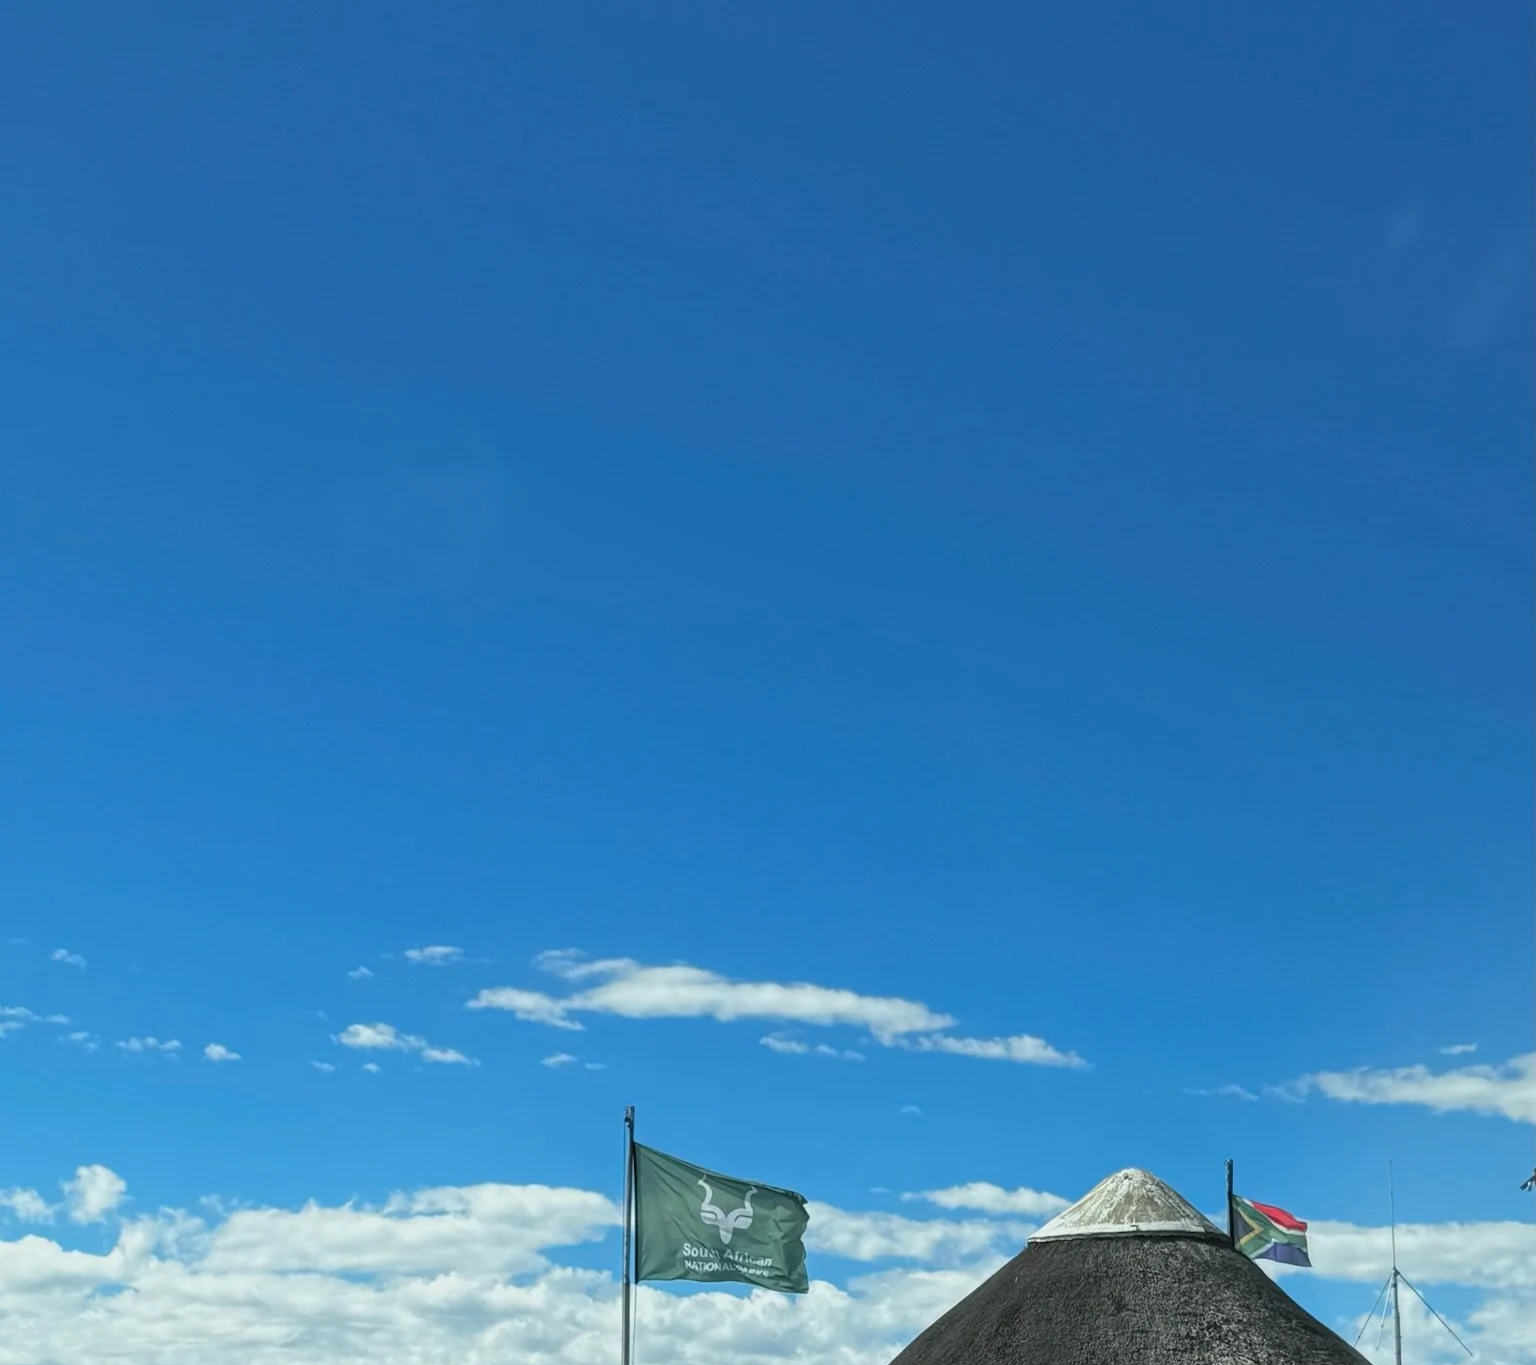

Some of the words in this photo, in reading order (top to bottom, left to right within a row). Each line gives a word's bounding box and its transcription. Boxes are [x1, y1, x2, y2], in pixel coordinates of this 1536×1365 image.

[682, 1243, 720, 1259] South
[724, 1249, 772, 1266] African
[685, 1260, 735, 1272] NATIONAL
